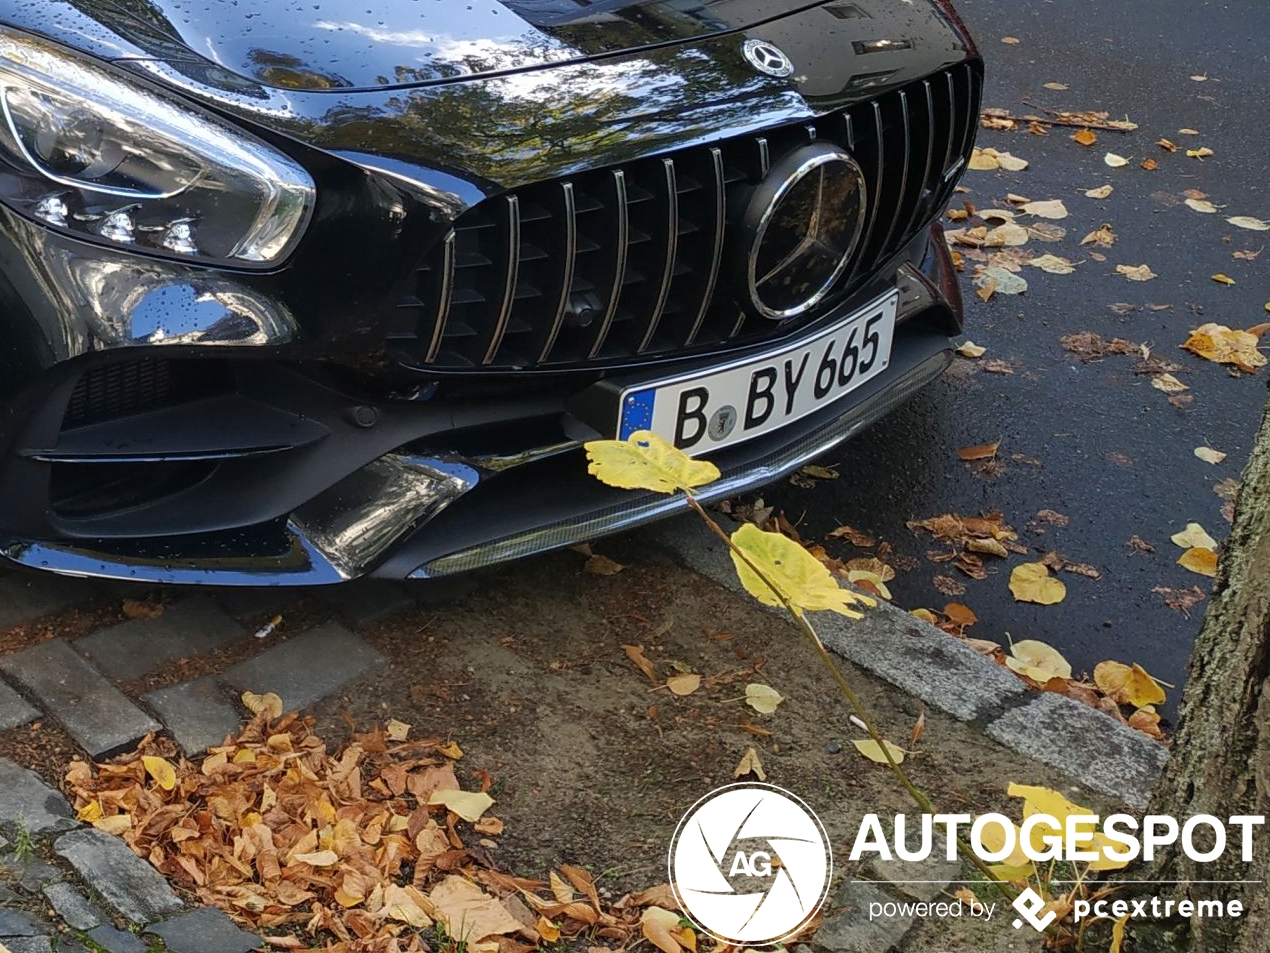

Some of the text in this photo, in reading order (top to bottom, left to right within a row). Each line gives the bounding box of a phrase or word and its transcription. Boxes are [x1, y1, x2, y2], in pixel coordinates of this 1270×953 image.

[673, 312, 884, 449] B BY 665
